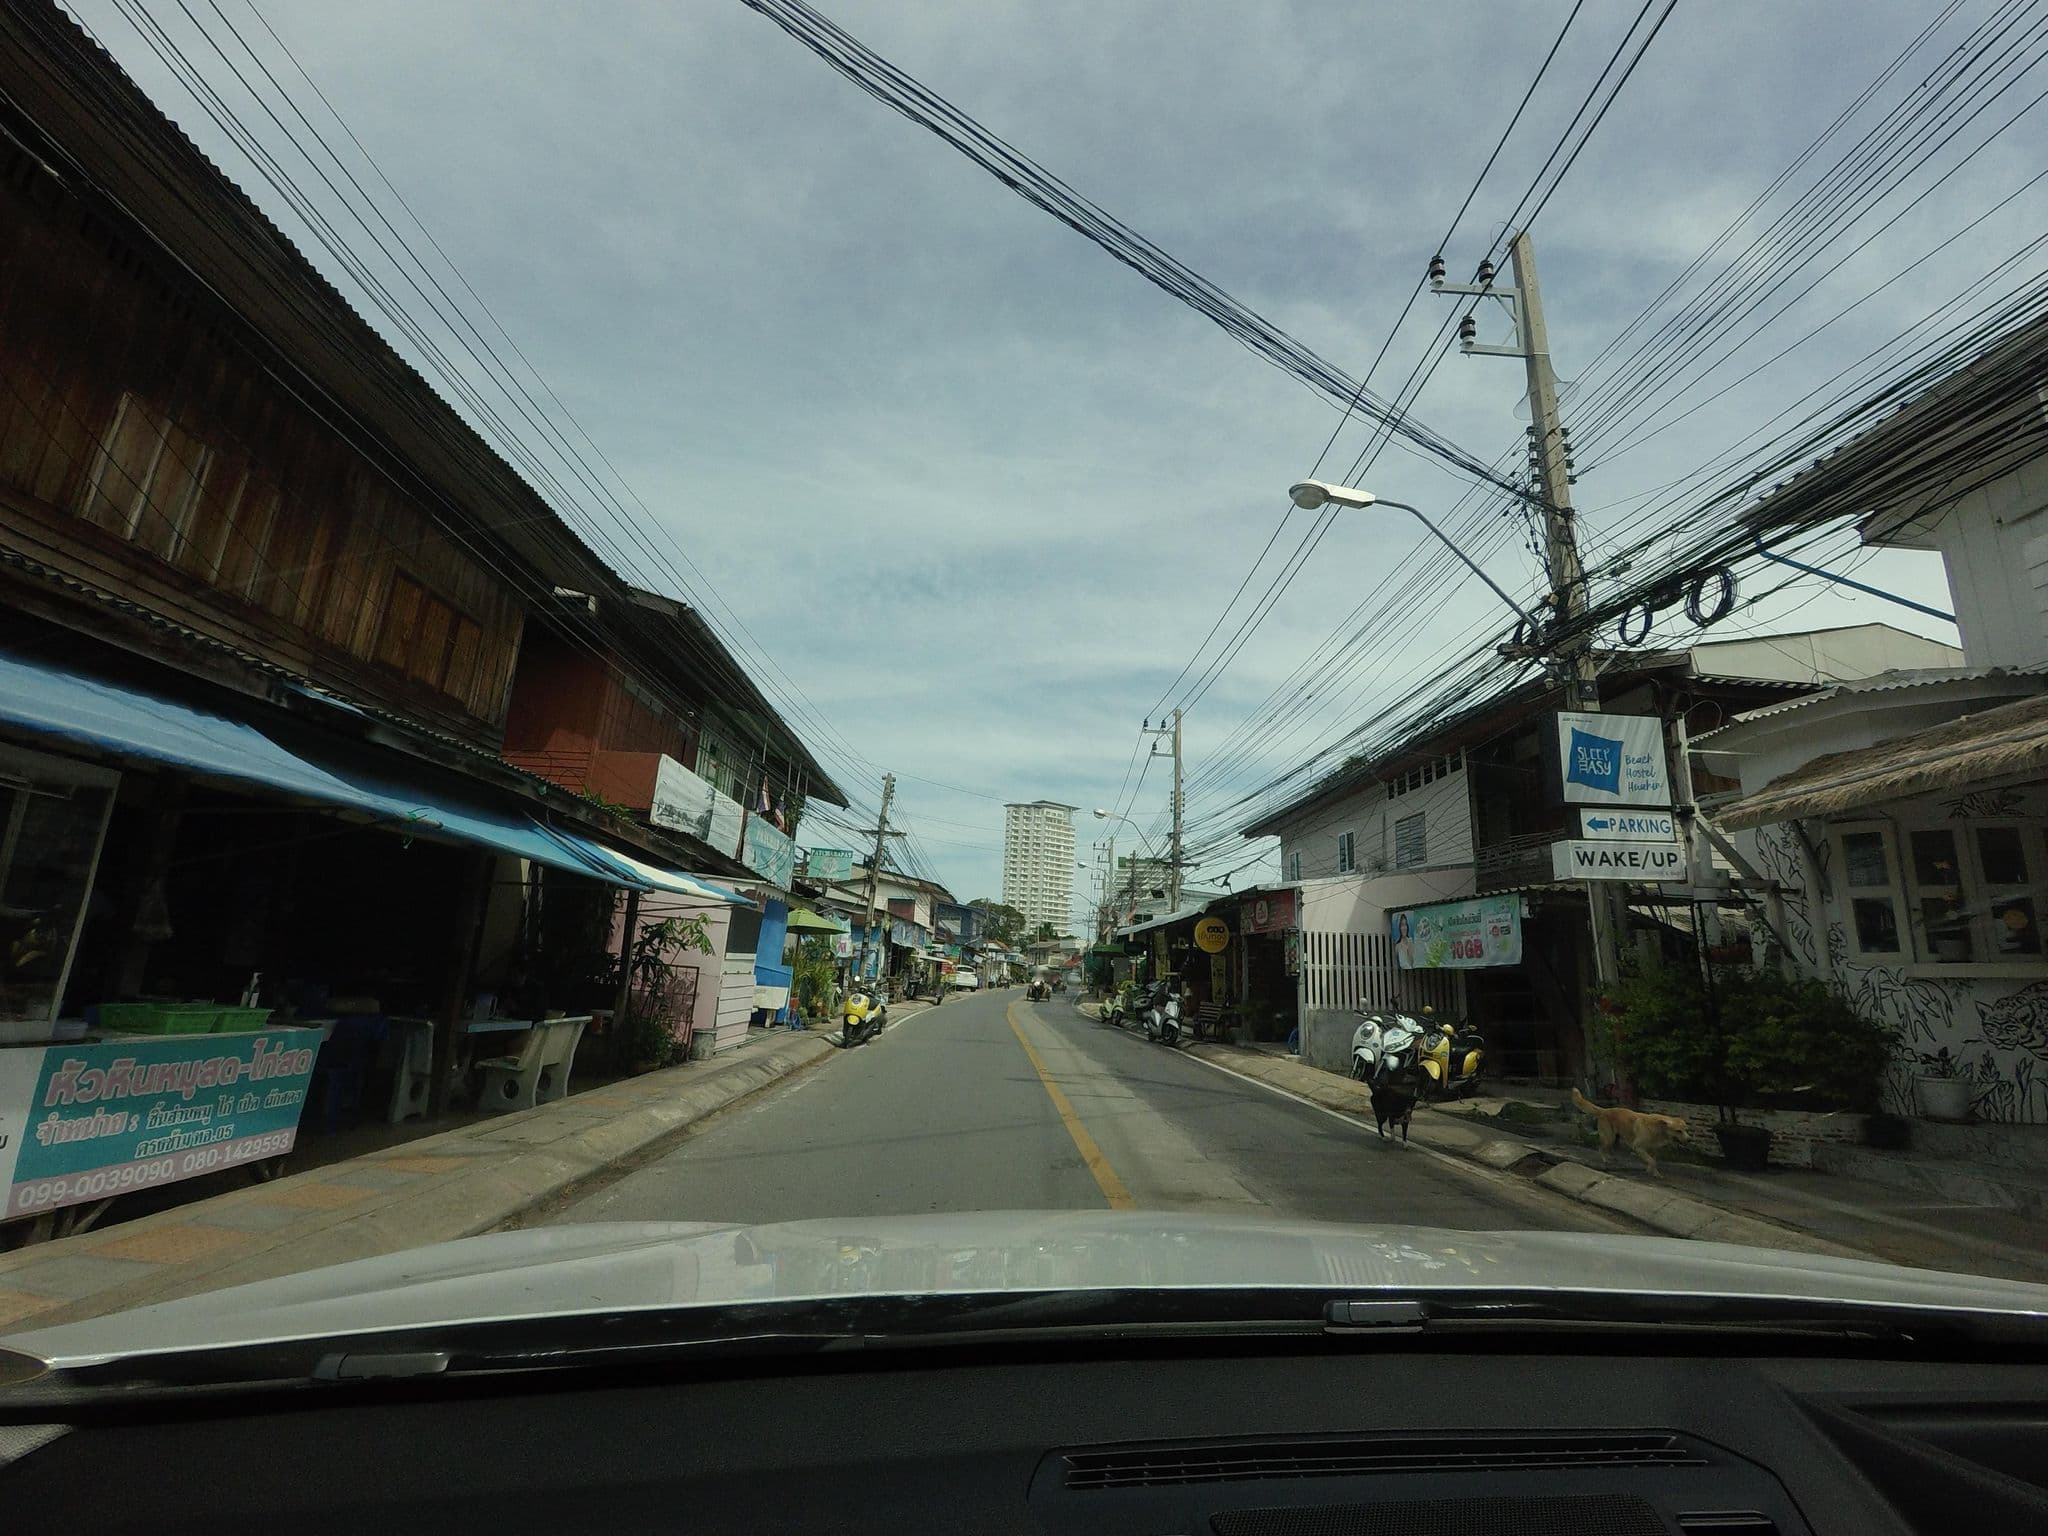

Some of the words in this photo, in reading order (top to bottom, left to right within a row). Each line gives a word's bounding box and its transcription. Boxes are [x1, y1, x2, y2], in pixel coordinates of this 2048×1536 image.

[1577, 746, 1610, 762] SLEEP
[1625, 752, 1653, 765] Beach
[1578, 760, 1612, 775] EASY
[1626, 766, 1656, 778] Hostel
[1609, 818, 1671, 834] PARKING
[1575, 850, 1678, 870] WAKE/UP
